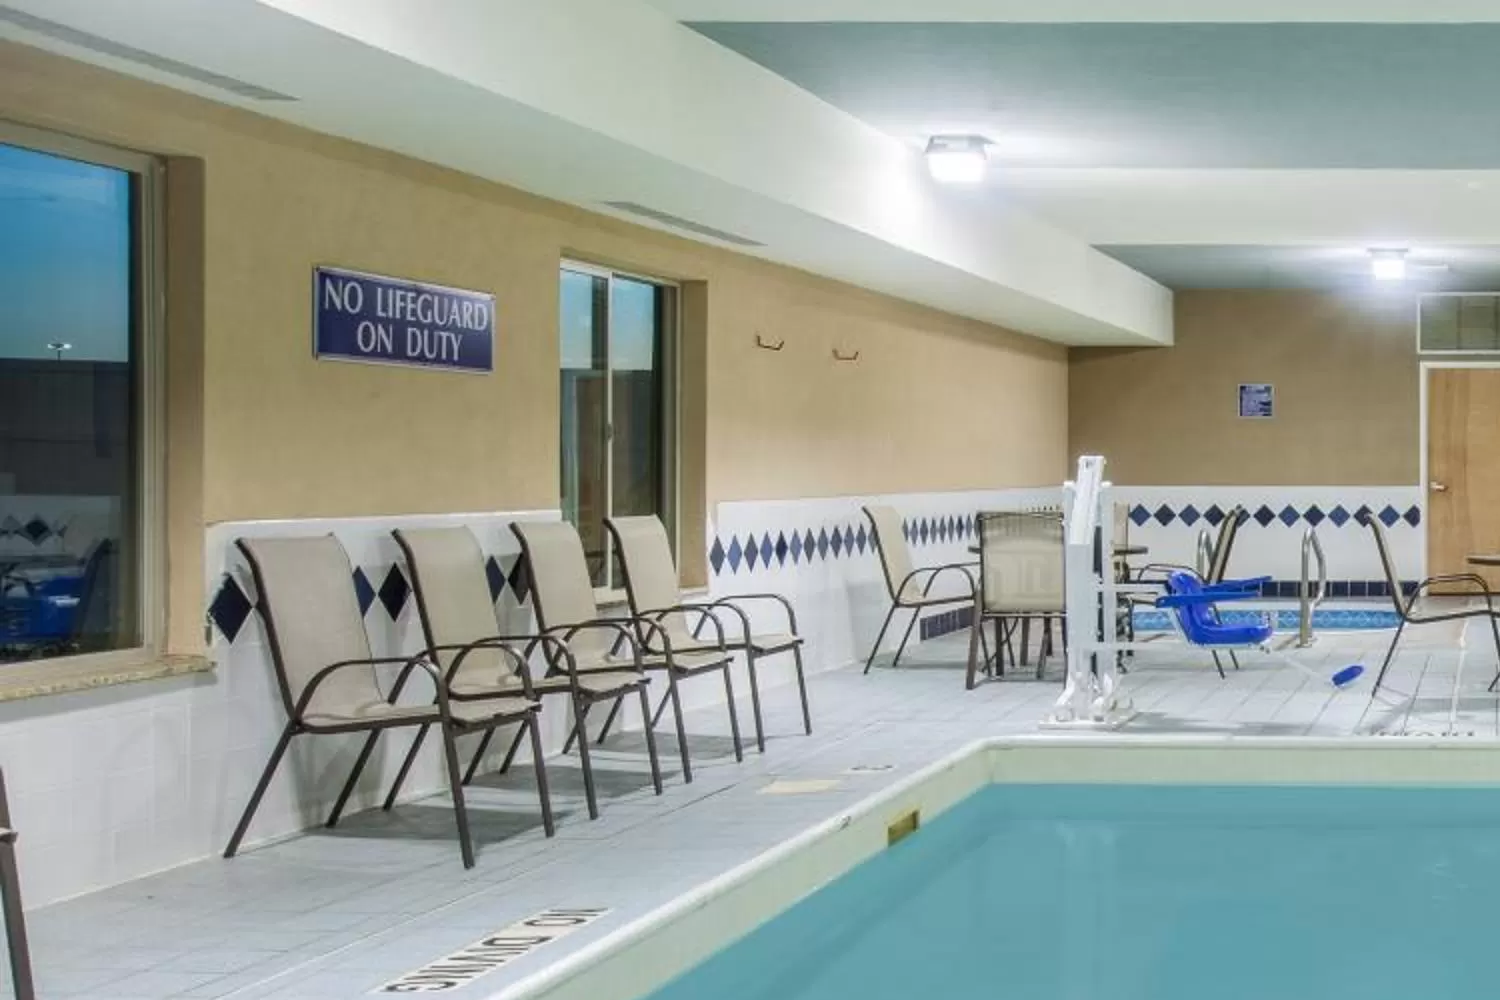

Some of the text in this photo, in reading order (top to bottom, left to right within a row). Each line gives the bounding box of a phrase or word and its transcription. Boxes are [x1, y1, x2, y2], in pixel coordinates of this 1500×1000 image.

[324, 278, 488, 331] NO LIFEGUARD
[357, 320, 463, 361] ON DUTY
[384, 907, 609, 992] NO DIVING
